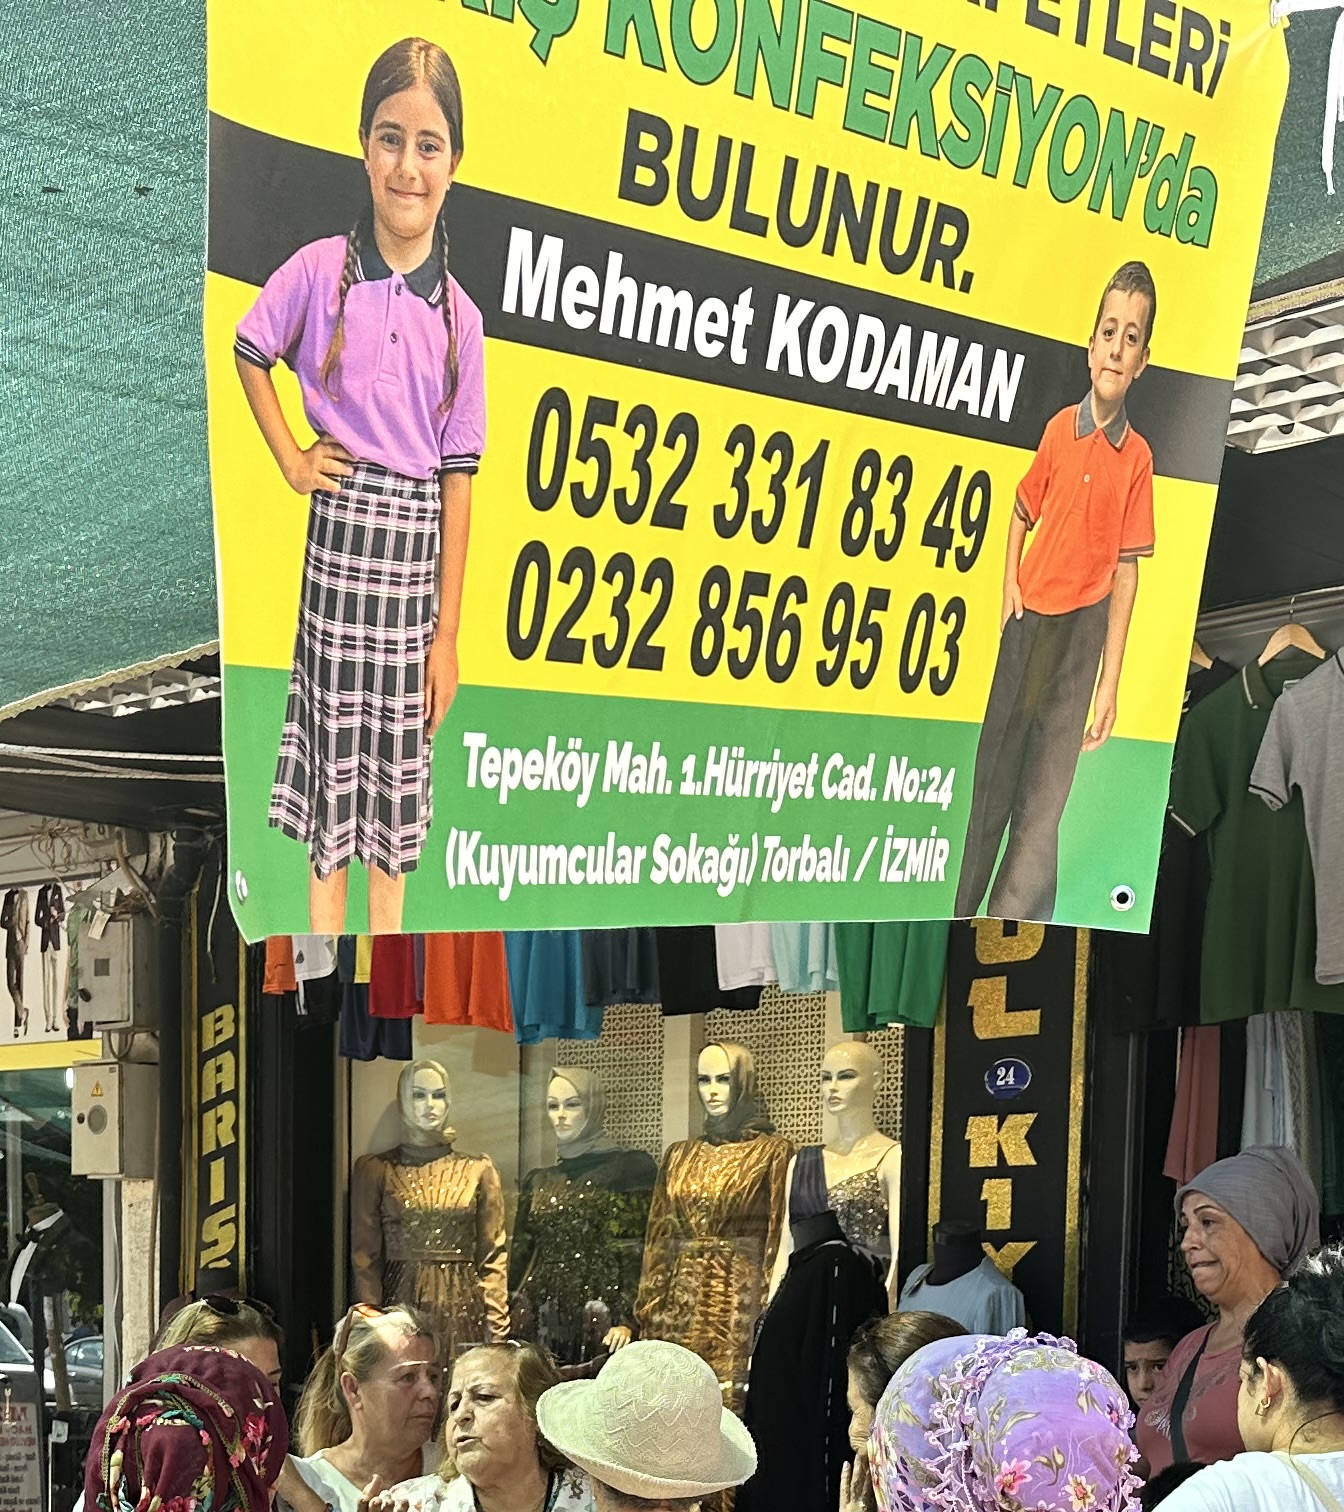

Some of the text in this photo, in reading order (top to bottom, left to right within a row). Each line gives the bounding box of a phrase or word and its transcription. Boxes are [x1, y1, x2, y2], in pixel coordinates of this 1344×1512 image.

[619, 108, 974, 292] BULUNUR.
[503, 227, 1025, 423] Mehmet KODAMAN
[526, 386, 991, 573] 0532 331 83 49
[506, 540, 966, 697] 0232 856 95 03
[463, 732, 955, 812] Tepeköy Mah. 1.Hürriyet Cad. No:24
[445, 825, 950, 901] (Kuyumcular Sokağı) Torbalı / İZMİR
[199, 1003, 237, 1270] BARIŞ
[996, 1066, 1015, 1086] 24
